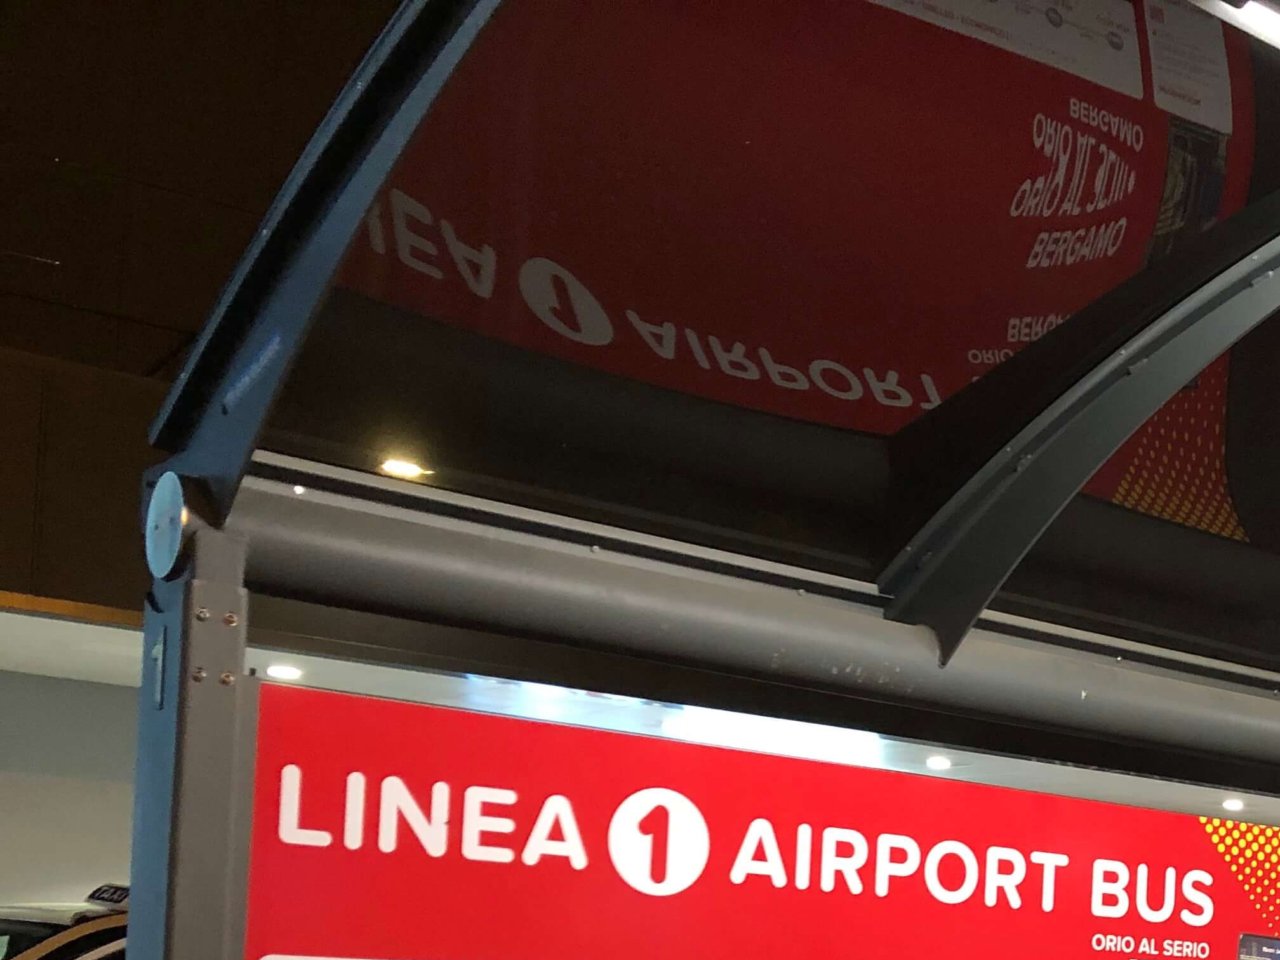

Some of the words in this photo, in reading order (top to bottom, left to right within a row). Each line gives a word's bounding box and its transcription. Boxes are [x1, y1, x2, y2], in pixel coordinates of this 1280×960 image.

[278, 764, 588, 871] LINEA
[729, 817, 1070, 912] AIRPORT
[1091, 858, 1215, 927] BUS
[1091, 933, 1135, 953] ORIO
[1138, 937, 1159, 955] AL
[1163, 939, 1210, 959] SERIO
